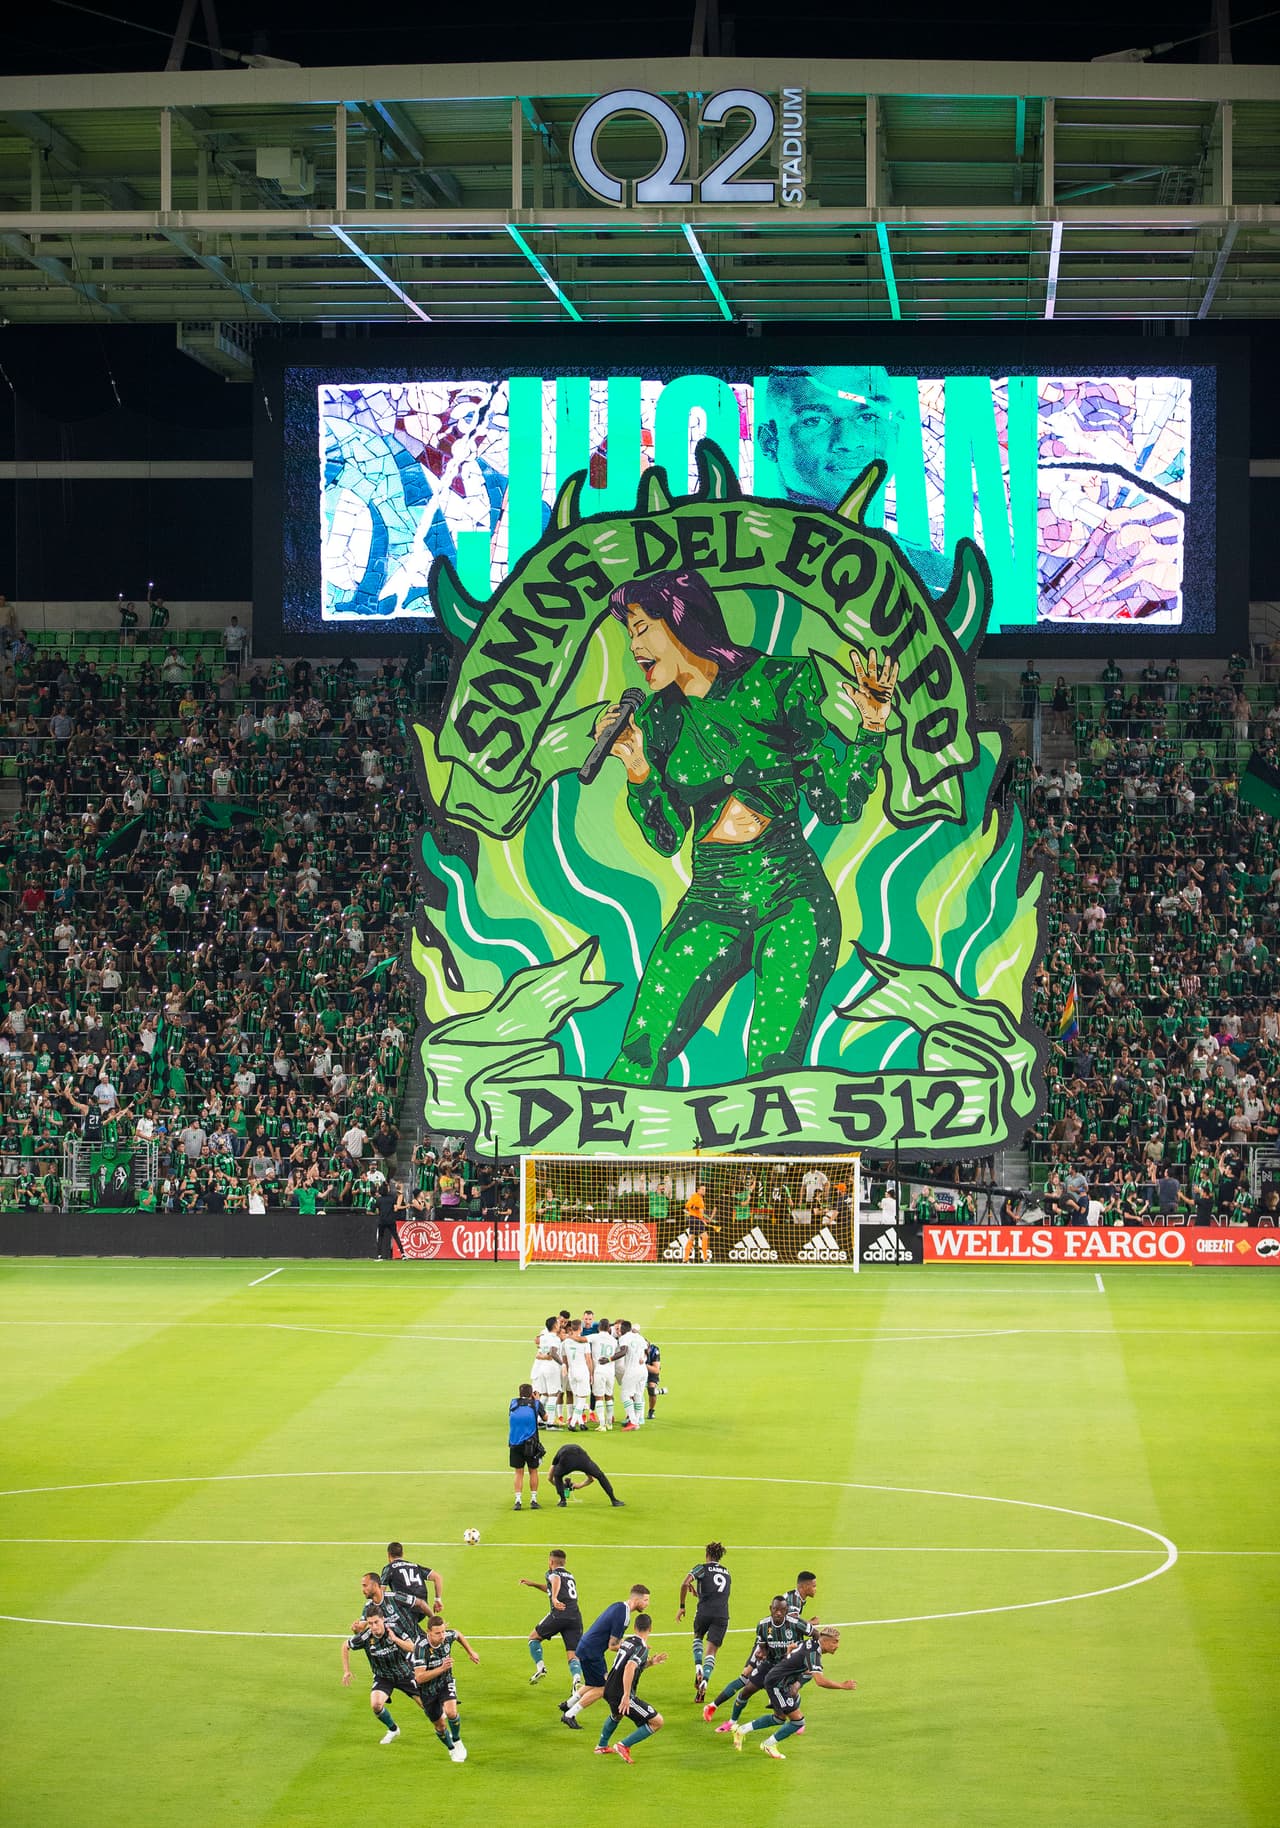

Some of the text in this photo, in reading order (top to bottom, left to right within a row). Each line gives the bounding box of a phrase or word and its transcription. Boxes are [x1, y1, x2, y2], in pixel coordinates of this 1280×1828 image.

[573, 88, 775, 203] Q2
[781, 87, 804, 203] STADIUM
[456, 510, 957, 772] SOMOS DEL EQUIPO
[510, 1079, 988, 1148] DE LA 512
[452, 1223, 599, 1258] Captain Morgan
[928, 1229, 1185, 1258] WELLS FARGO
[728, 1247, 778, 1260] adidas
[798, 1248, 847, 1260] adidas
[600, 1343, 613, 1356] 10
[399, 1568, 423, 1586] 14
[567, 1579, 578, 1599] 8
[713, 1573, 727, 1593] 9
